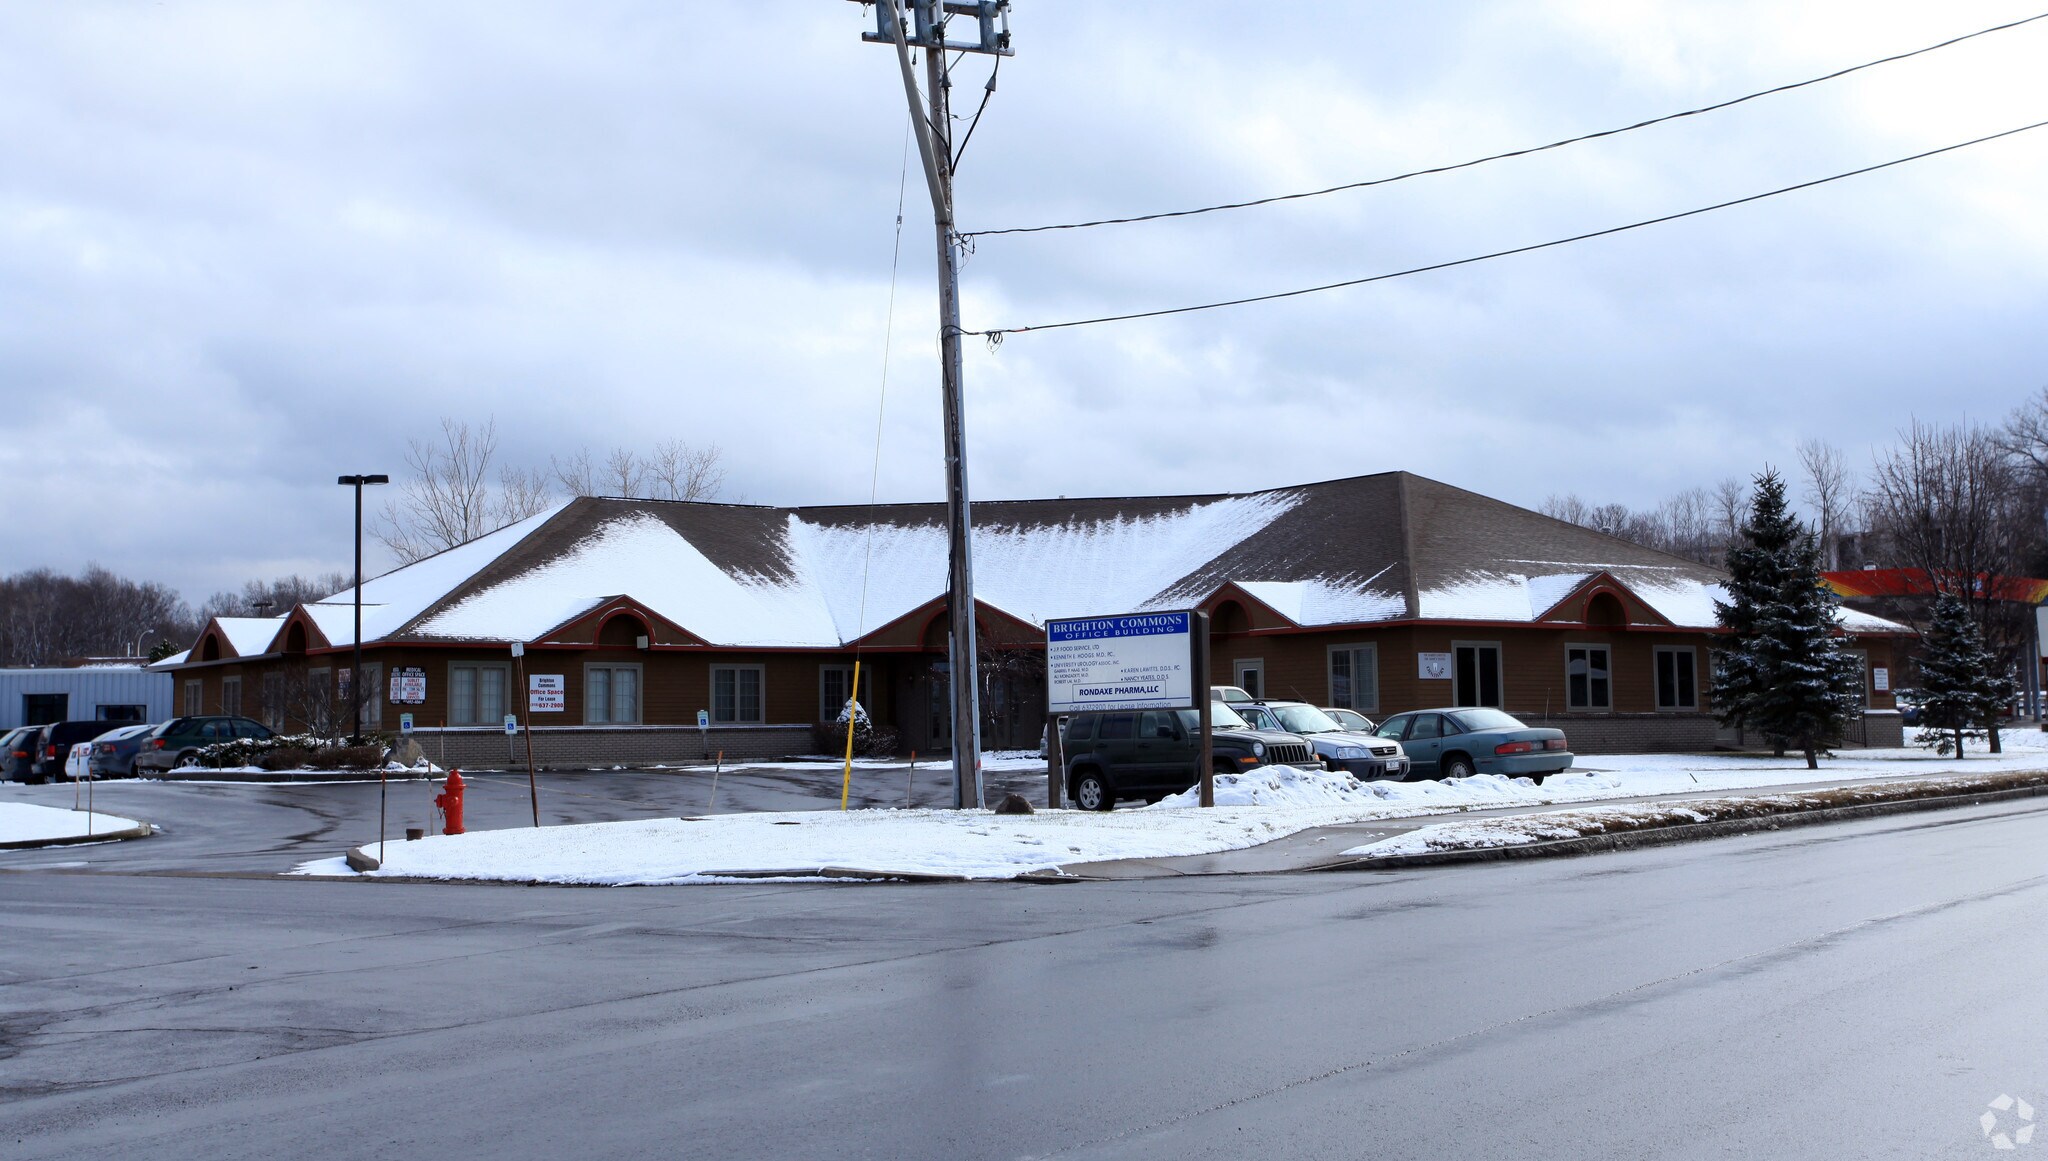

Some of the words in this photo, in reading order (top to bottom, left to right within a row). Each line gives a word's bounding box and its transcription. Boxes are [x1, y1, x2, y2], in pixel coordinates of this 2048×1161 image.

[1053, 620, 1114, 633] BRIGHTON
[1120, 615, 1182, 629] COMMONS
[1065, 631, 1108, 640] OFFICE
[1115, 626, 1175, 636] BUILDING
[1079, 687, 1113, 696] RONDAXE
[1114, 685, 1159, 695] PHARMA,LLC
[1137, 701, 1171, 709] Information
